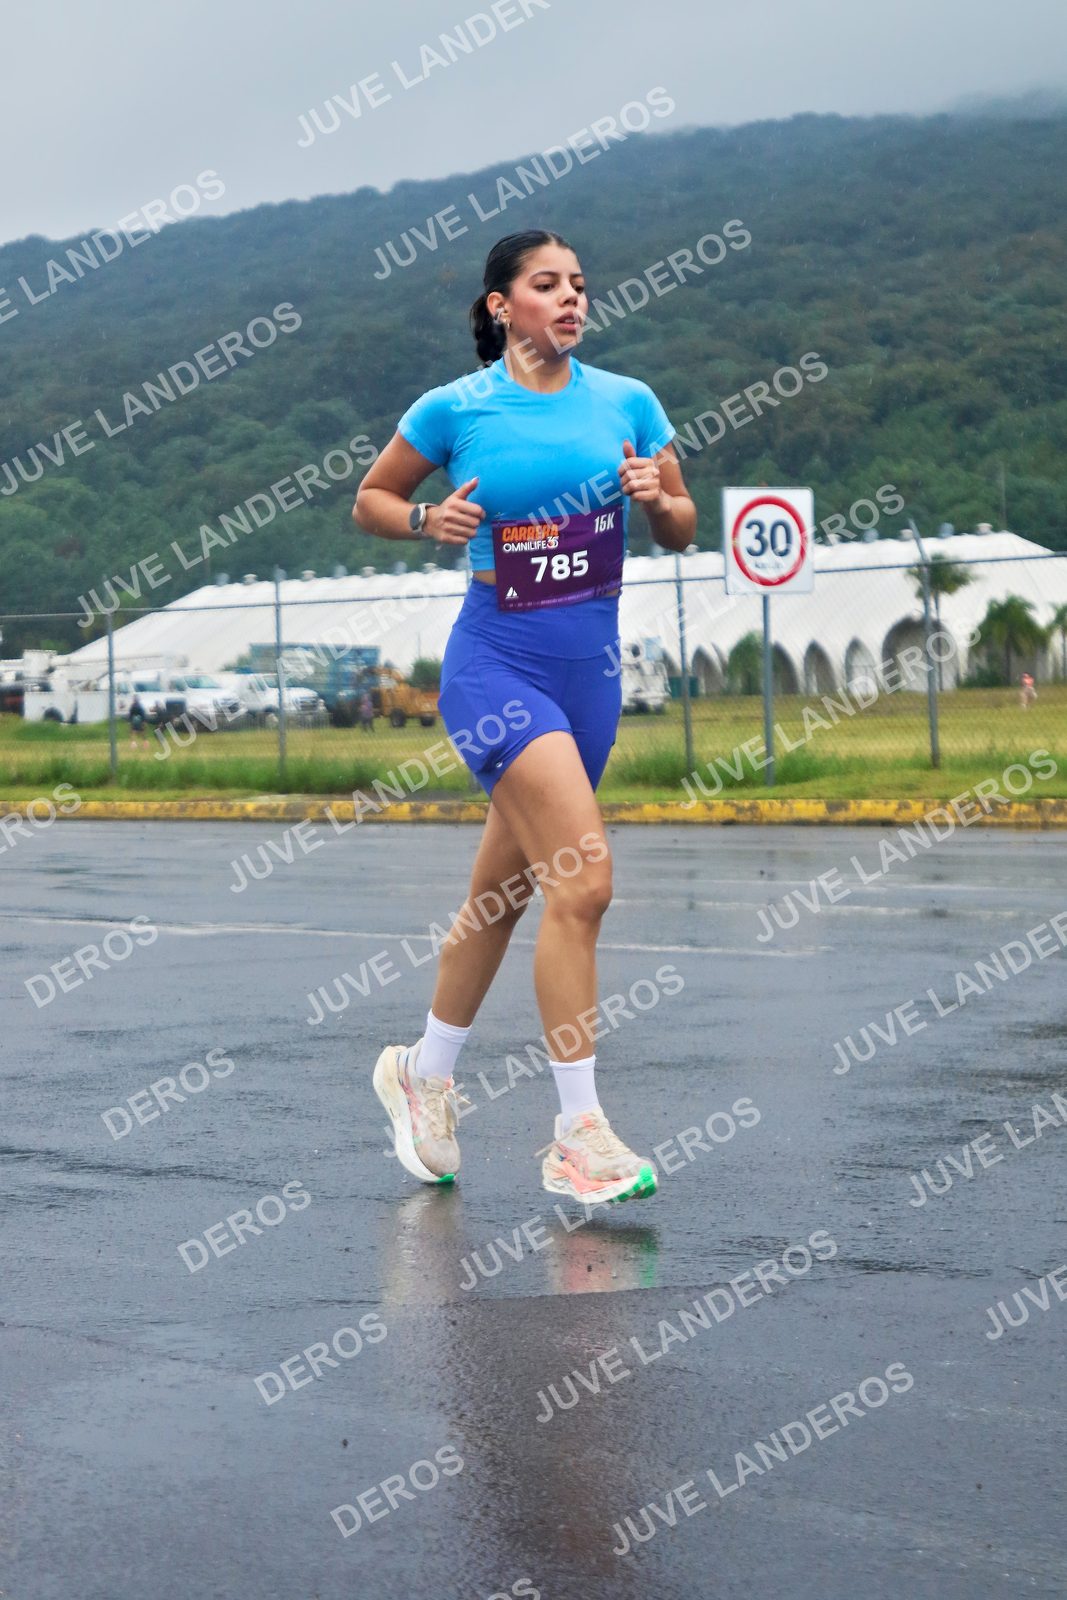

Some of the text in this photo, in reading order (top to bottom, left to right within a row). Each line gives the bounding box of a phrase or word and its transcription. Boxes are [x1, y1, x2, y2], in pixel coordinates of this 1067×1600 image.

[502, 524, 559, 542] CARRERA
[594, 512, 615, 534] 15K
[503, 540, 547, 552] OMNILIFE
[745, 519, 792, 557] 30
[531, 550, 589, 583] 785
